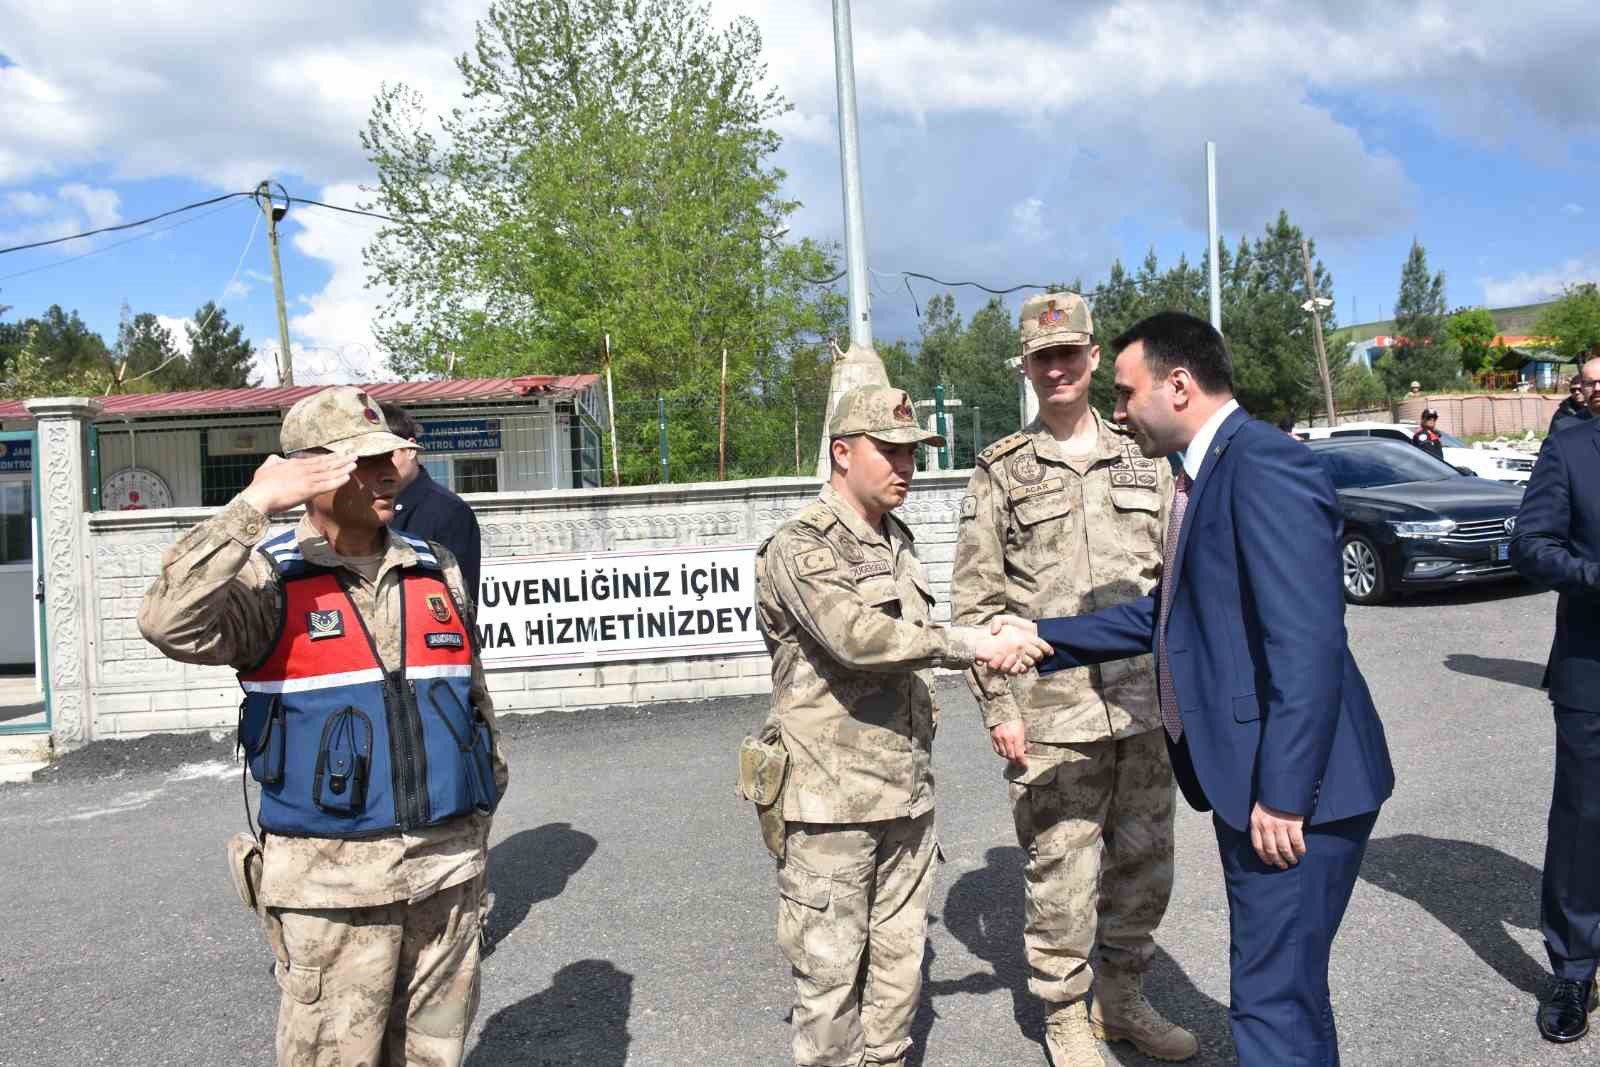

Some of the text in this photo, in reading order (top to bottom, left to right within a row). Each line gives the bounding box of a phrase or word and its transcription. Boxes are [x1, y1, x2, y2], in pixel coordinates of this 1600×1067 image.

[1024, 483, 1049, 494] ACAR
[482, 566, 671, 608] ÜVENLİĞİNİZ
[681, 562, 740, 601] İÇİN
